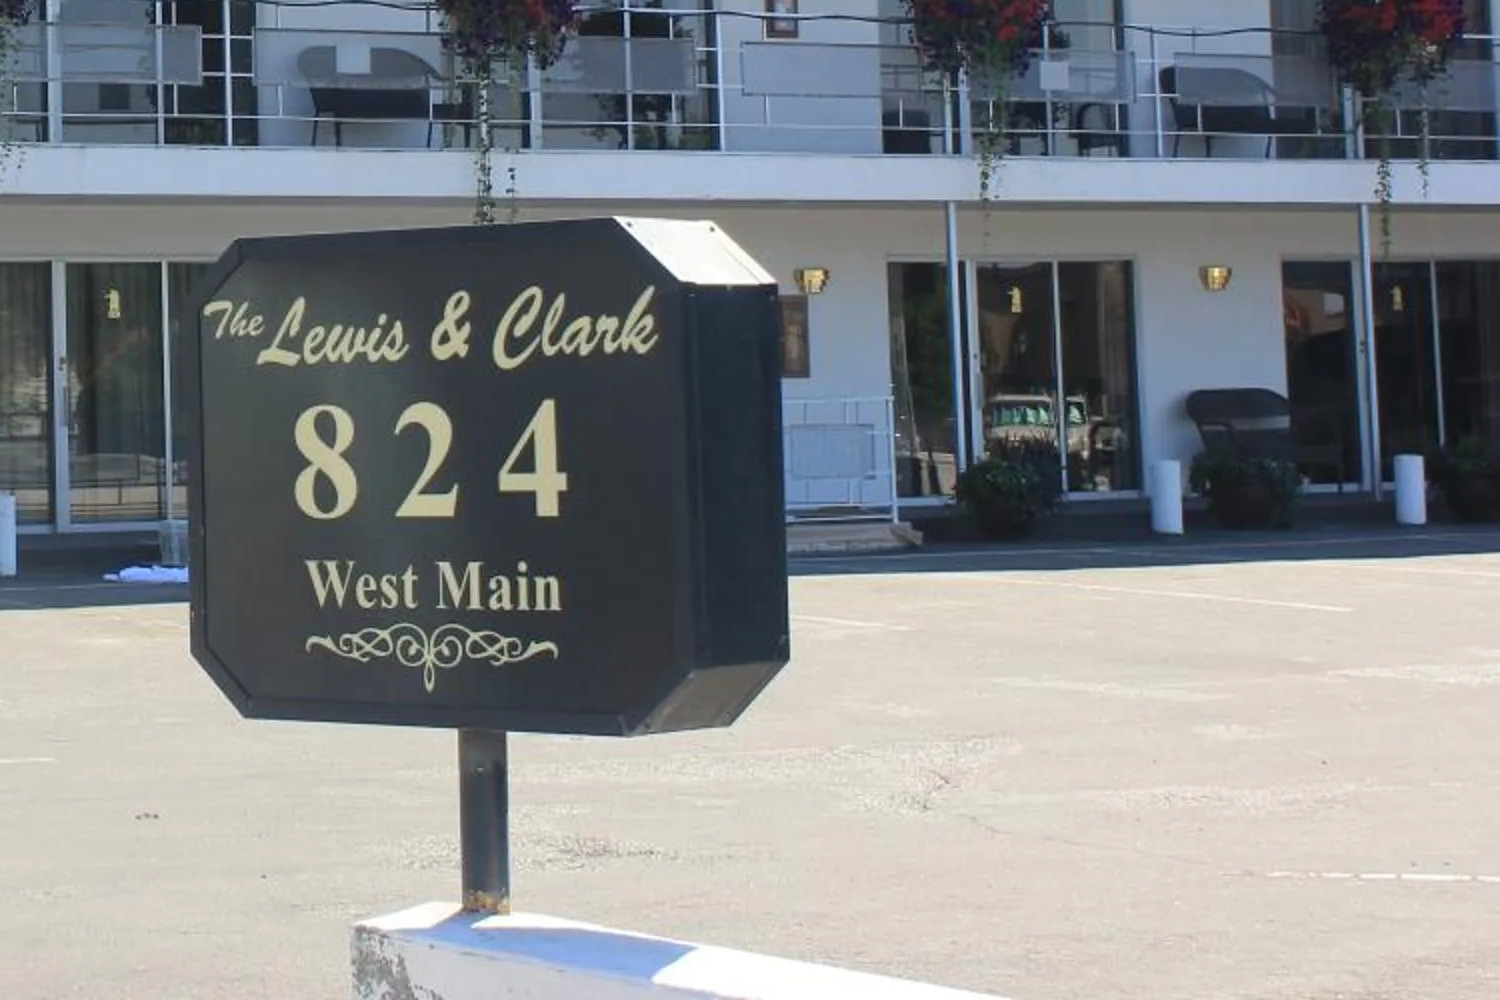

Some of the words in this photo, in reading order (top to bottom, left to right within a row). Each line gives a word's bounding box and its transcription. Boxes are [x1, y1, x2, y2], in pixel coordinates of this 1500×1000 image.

[203, 300, 265, 339] The
[256, 296, 409, 367] Lewis
[430, 290, 472, 361] &
[491, 285, 660, 371] Clark
[304, 559, 419, 610] West
[435, 559, 563, 612] Main
